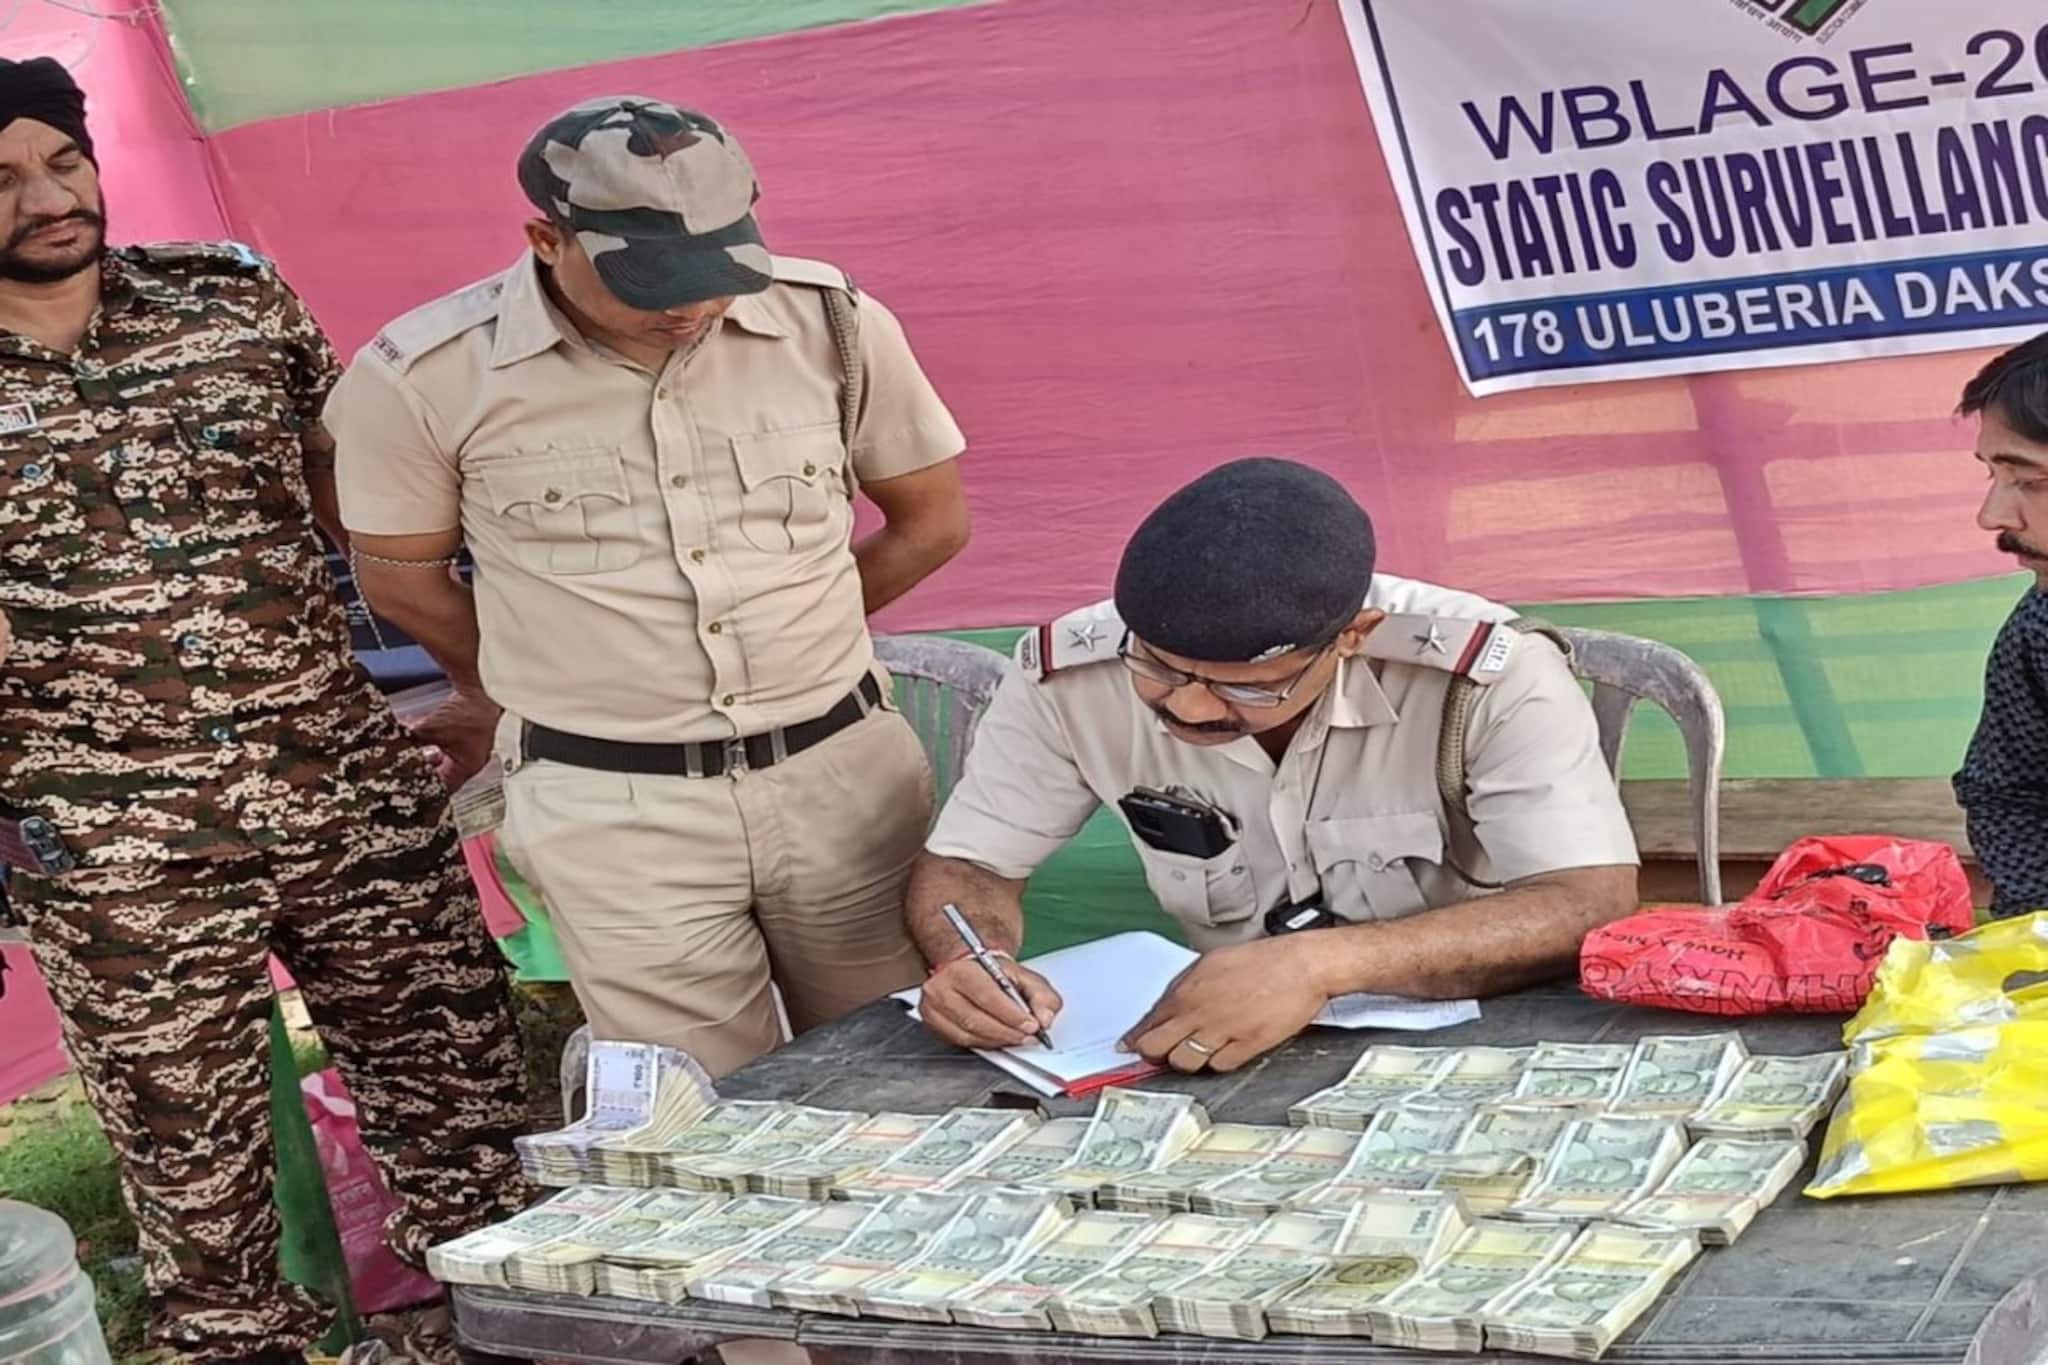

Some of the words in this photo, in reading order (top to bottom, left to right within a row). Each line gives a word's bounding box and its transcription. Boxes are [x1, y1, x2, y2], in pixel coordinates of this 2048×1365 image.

[1461, 23, 2048, 161] WBLAGE-2
[1435, 168, 1637, 287] STATIC
[1473, 310, 1563, 361] 178
[1576, 278, 1885, 349] ULUBERIA
